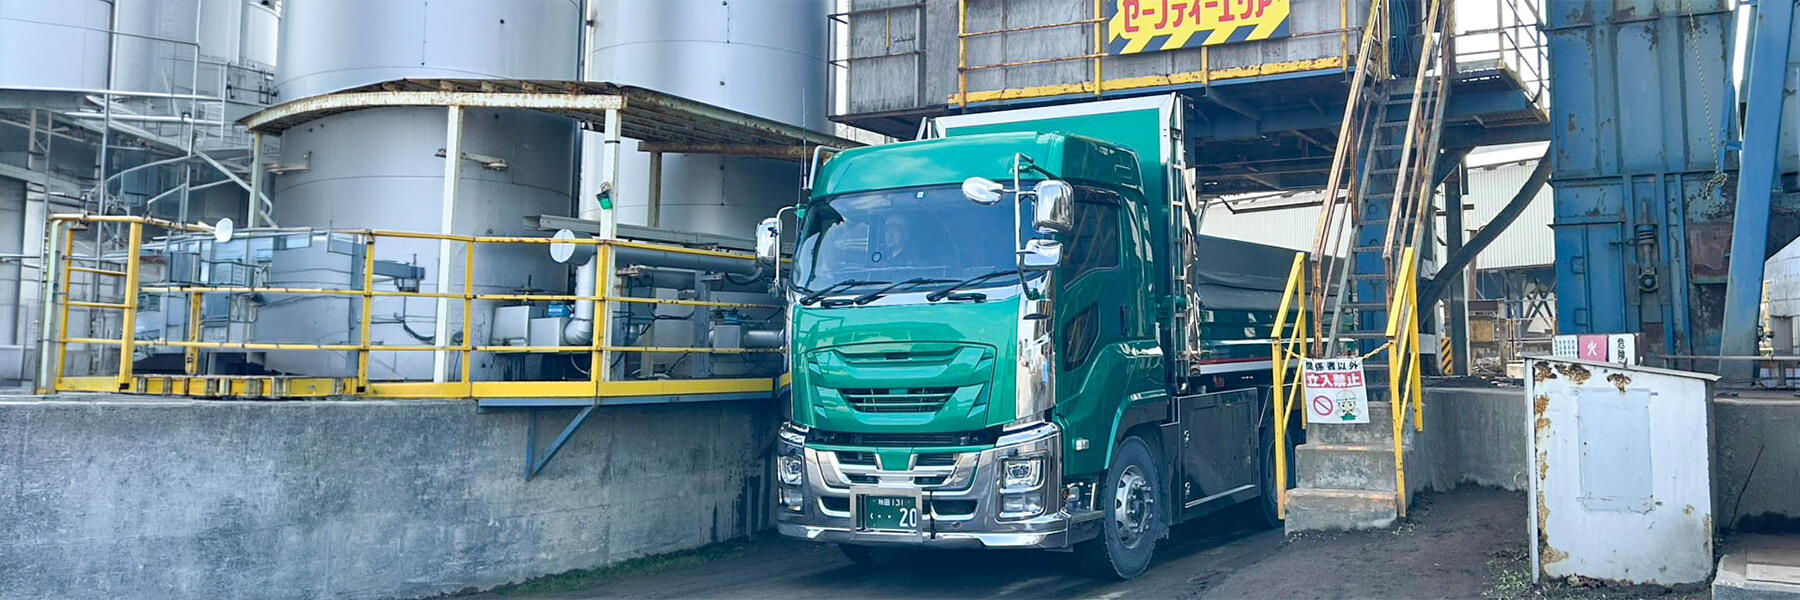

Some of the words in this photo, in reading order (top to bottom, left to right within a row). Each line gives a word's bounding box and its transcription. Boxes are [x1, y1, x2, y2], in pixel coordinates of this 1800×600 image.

[1587, 340, 1598, 357] 火
[1617, 338, 1626, 364] 危険
[1305, 361, 1358, 371] 関係者以外
[1306, 373, 1362, 387] 立入禁止
